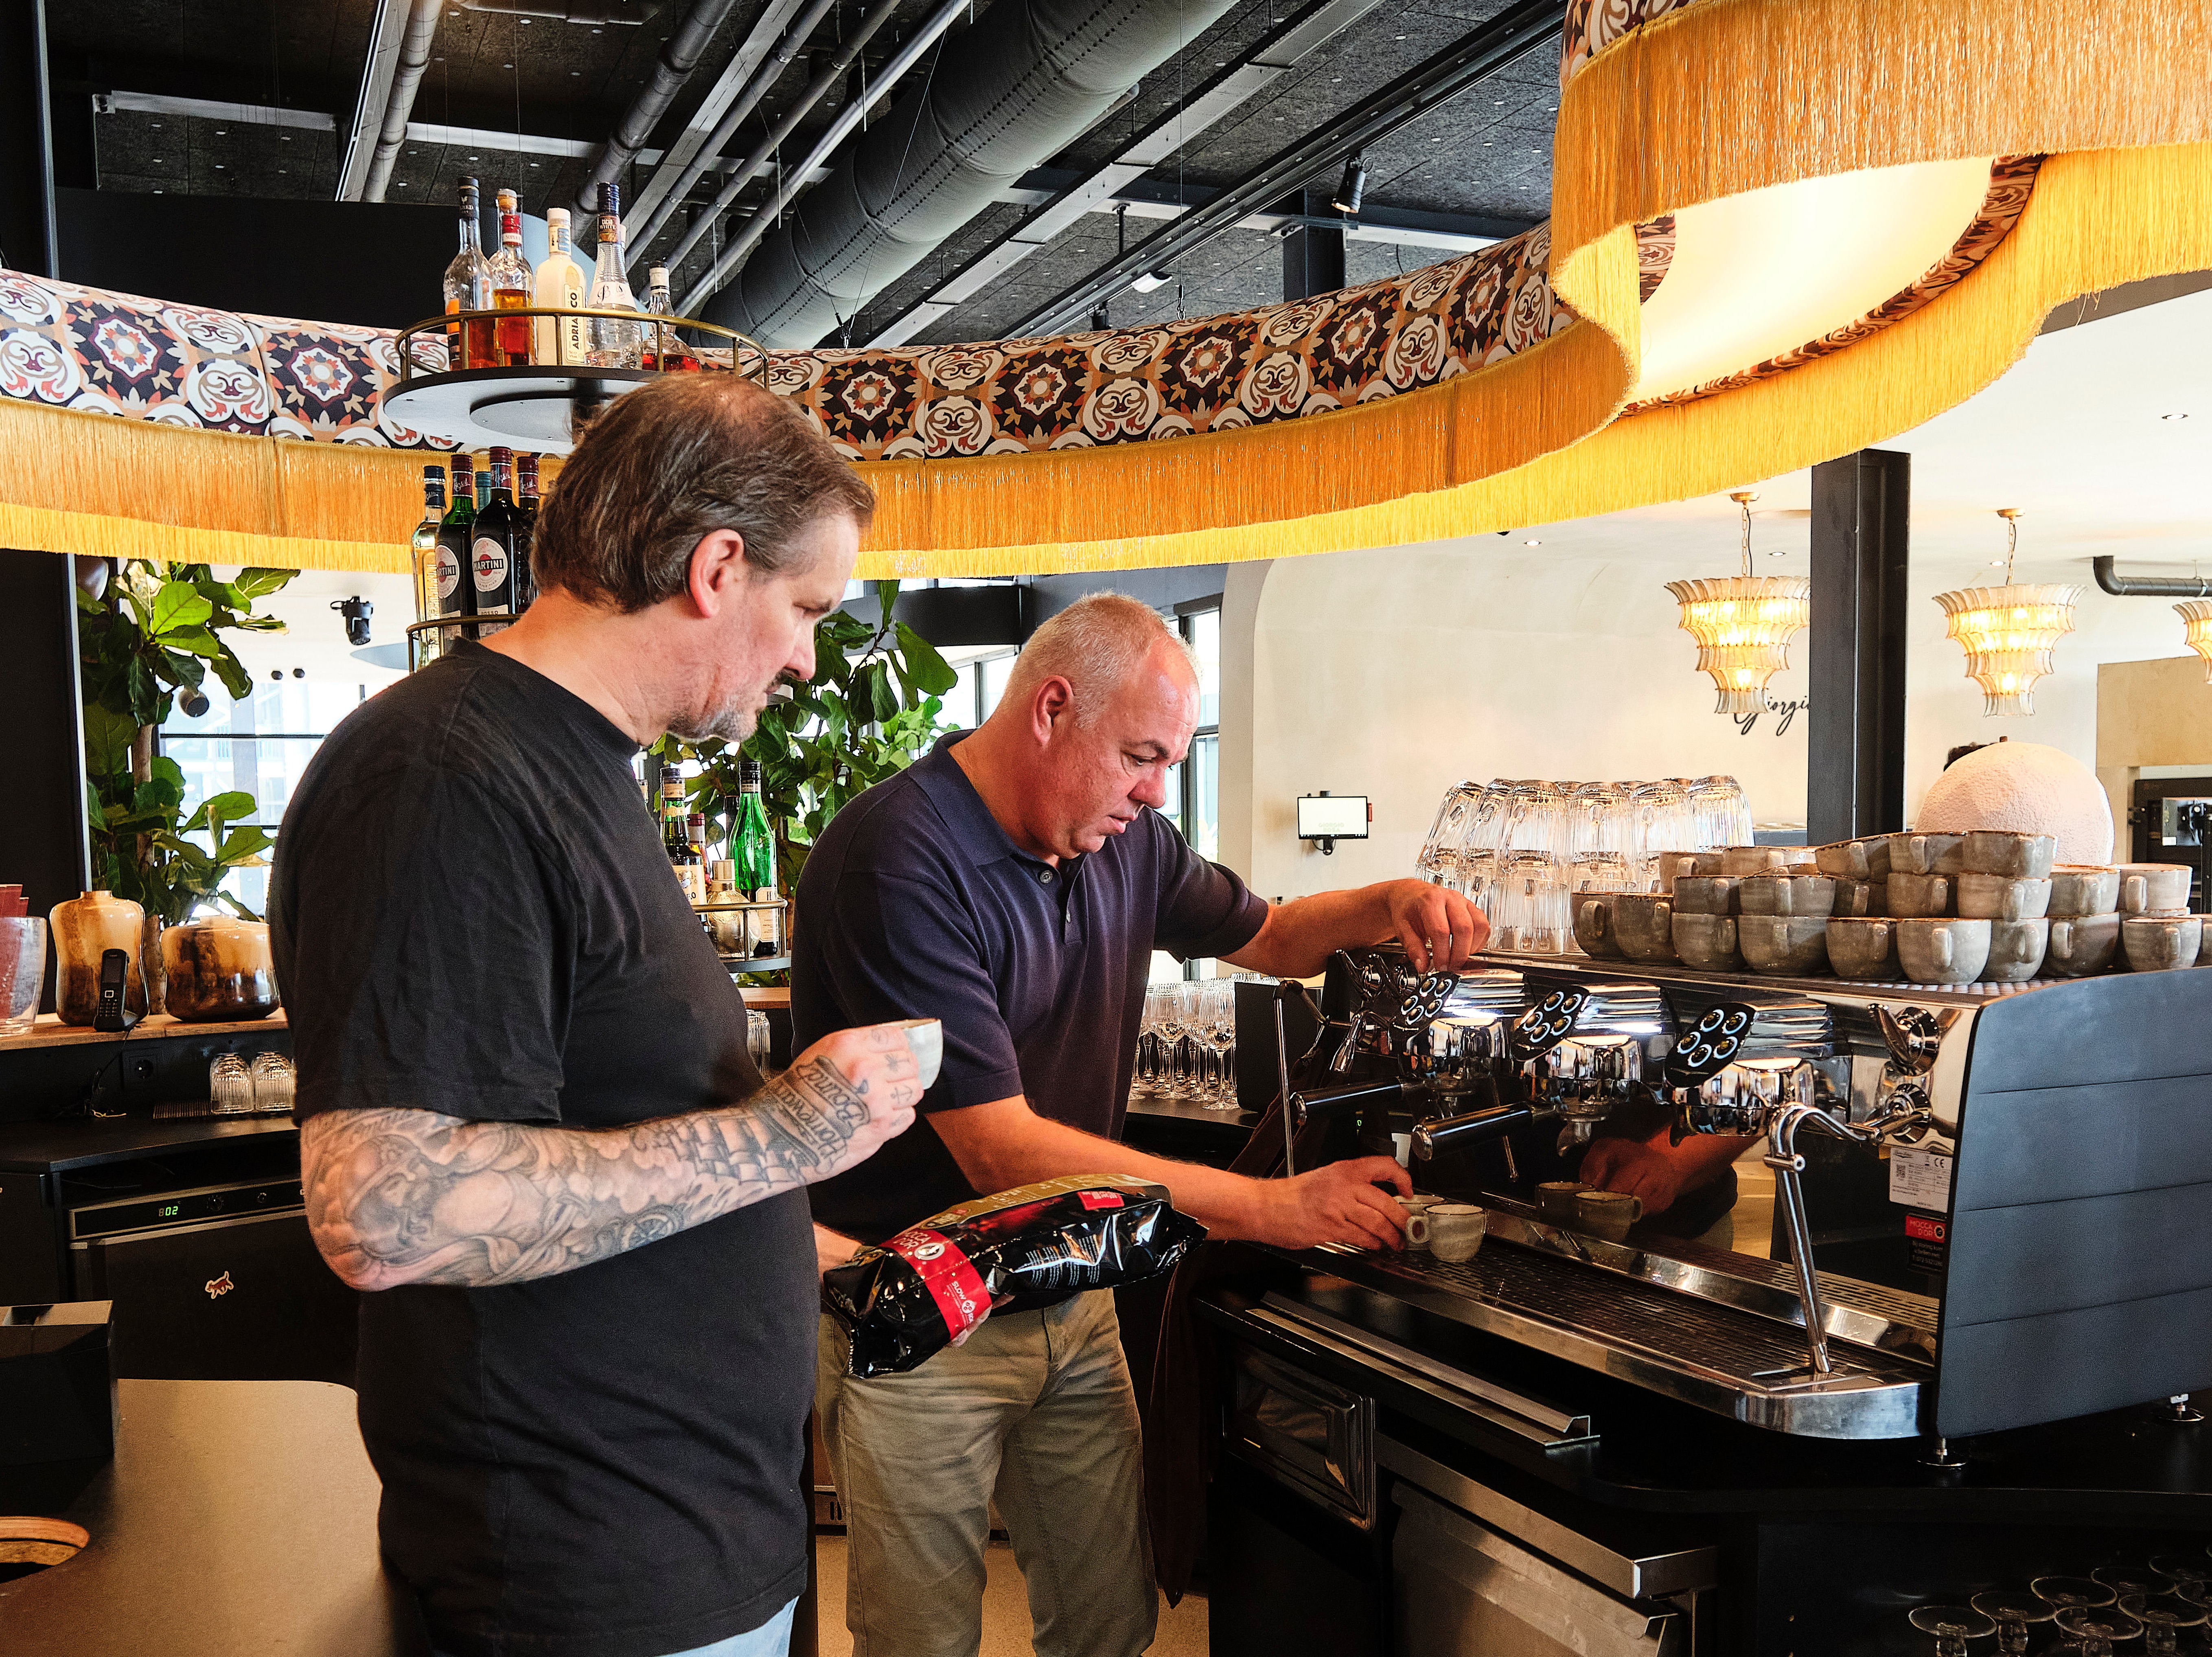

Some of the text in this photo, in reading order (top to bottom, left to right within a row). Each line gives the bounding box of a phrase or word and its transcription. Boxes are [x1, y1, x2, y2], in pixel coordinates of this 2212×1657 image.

[570, 292, 579, 350] ADRIACO
[473, 559, 503, 571] MARTINI
[807, 1072, 865, 1123] Bound
[1910, 1220, 1933, 1230] MOCCA
[951, 1281, 966, 1300] SLOW
